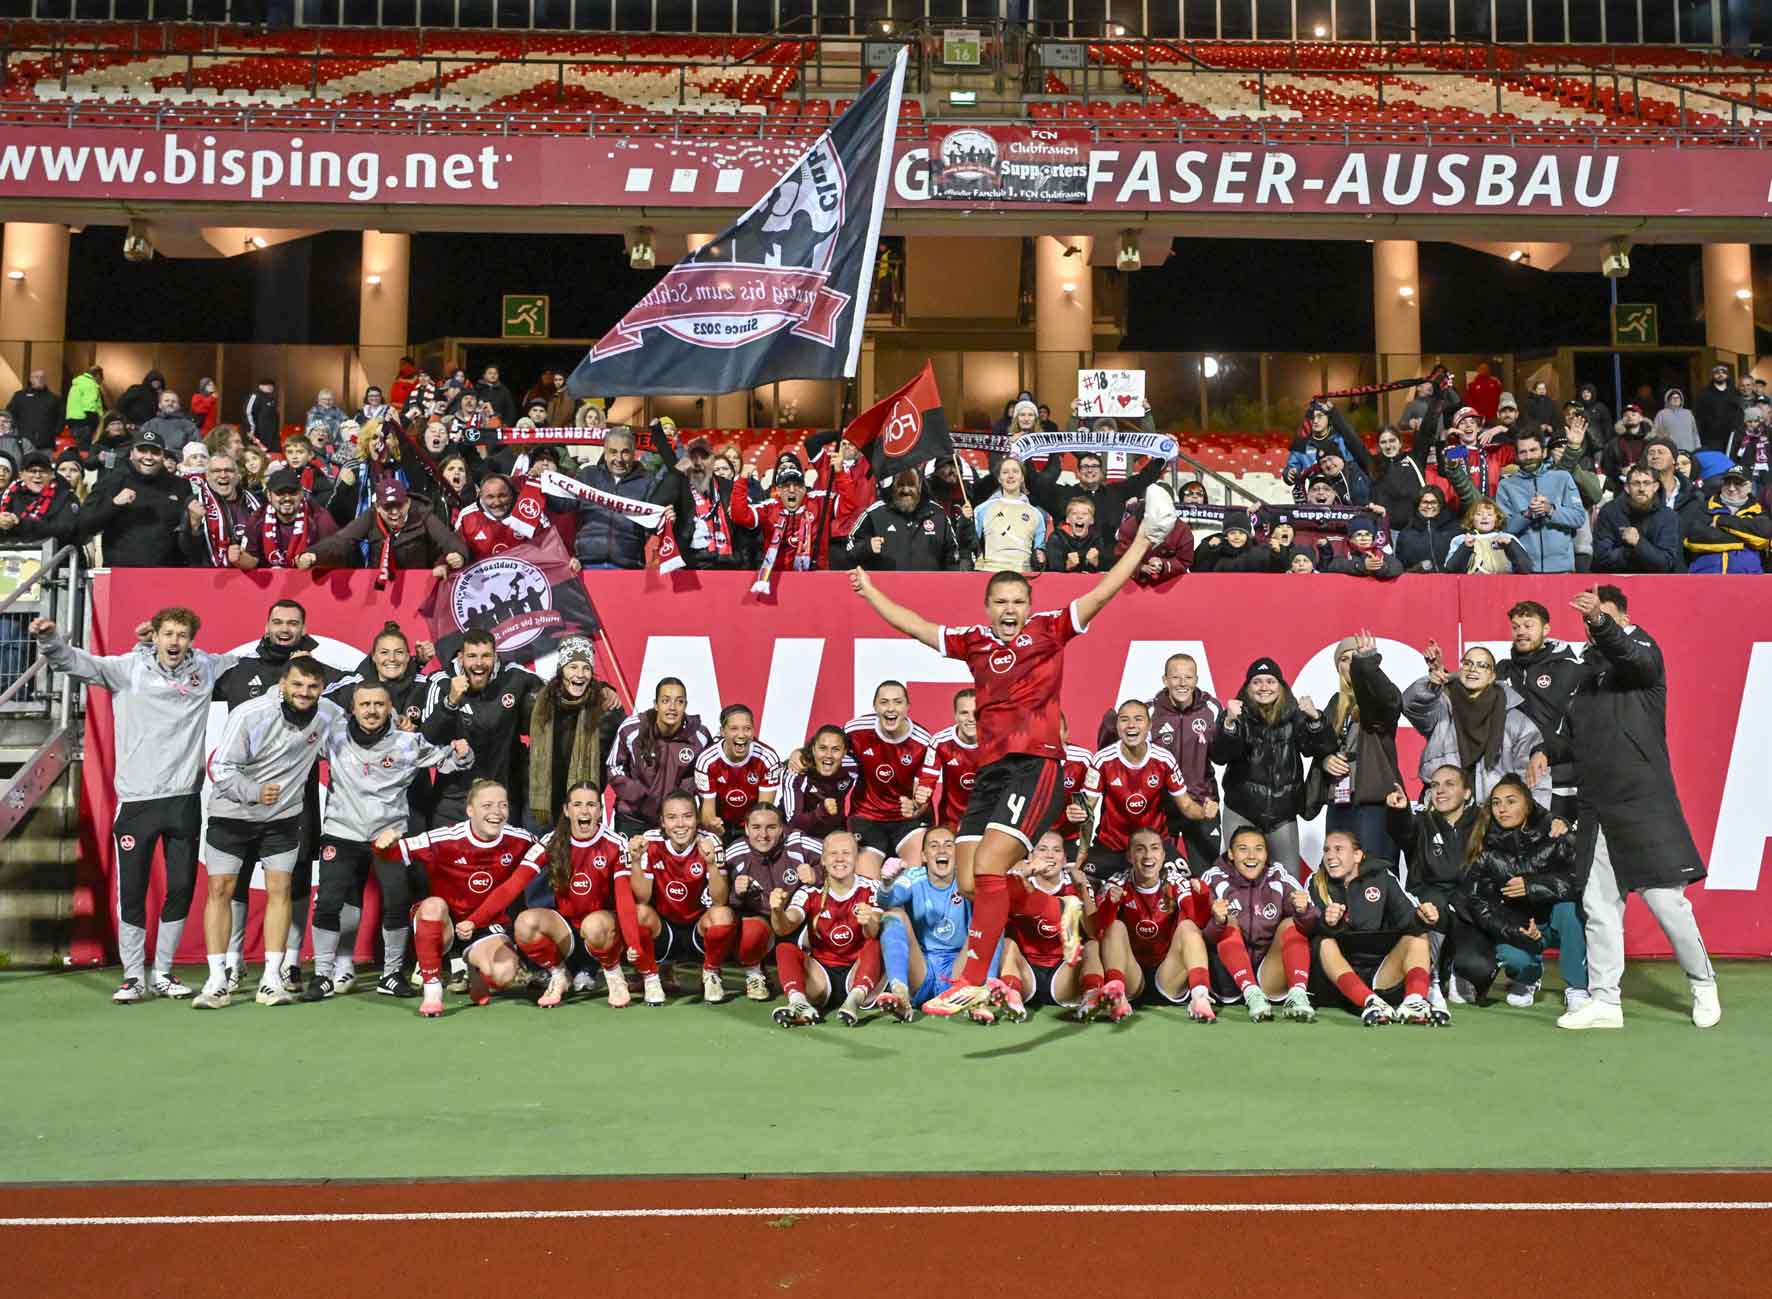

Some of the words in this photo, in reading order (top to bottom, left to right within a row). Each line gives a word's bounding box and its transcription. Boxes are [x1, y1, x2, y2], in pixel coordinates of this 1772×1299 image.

[1031, 130, 1058, 139] FCN
[1009, 142, 1079, 155] Clubfrauen
[0, 134, 499, 200] www.bisping.net
[1001, 160, 1087, 180] Supporters
[1082, 371, 1108, 391] #18
[1082, 394, 1104, 414] #1
[512, 428, 531, 439] FC
[1007, 793, 1026, 825] 4
